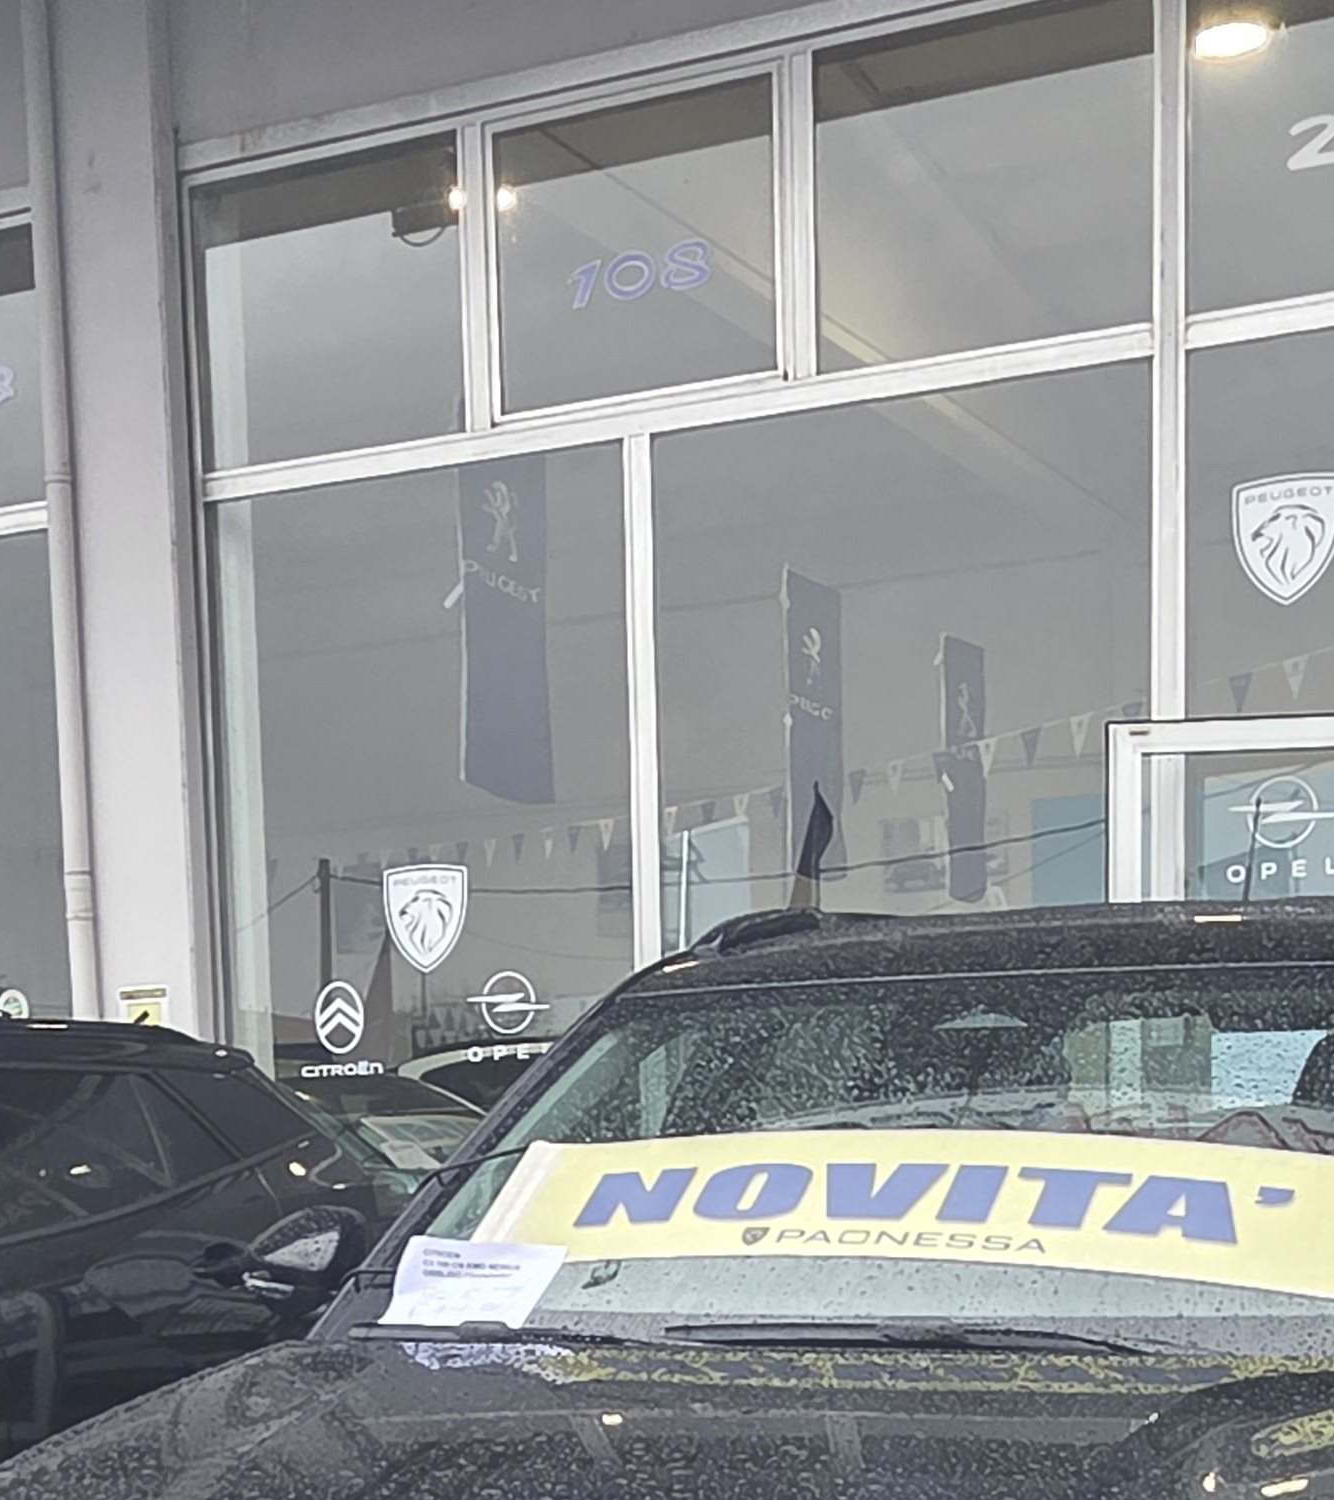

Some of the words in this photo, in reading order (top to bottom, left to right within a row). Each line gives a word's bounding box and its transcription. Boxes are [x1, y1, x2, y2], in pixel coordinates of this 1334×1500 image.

[568, 239, 712, 309] 108
[1244, 485, 1334, 505] PEUGEOT
[392, 875, 457, 887] PEUGEOT
[301, 1060, 384, 1078] CITROËN
[573, 1162, 1296, 1246] NOVITA'
[775, 1229, 1047, 1254] PAONESSA
